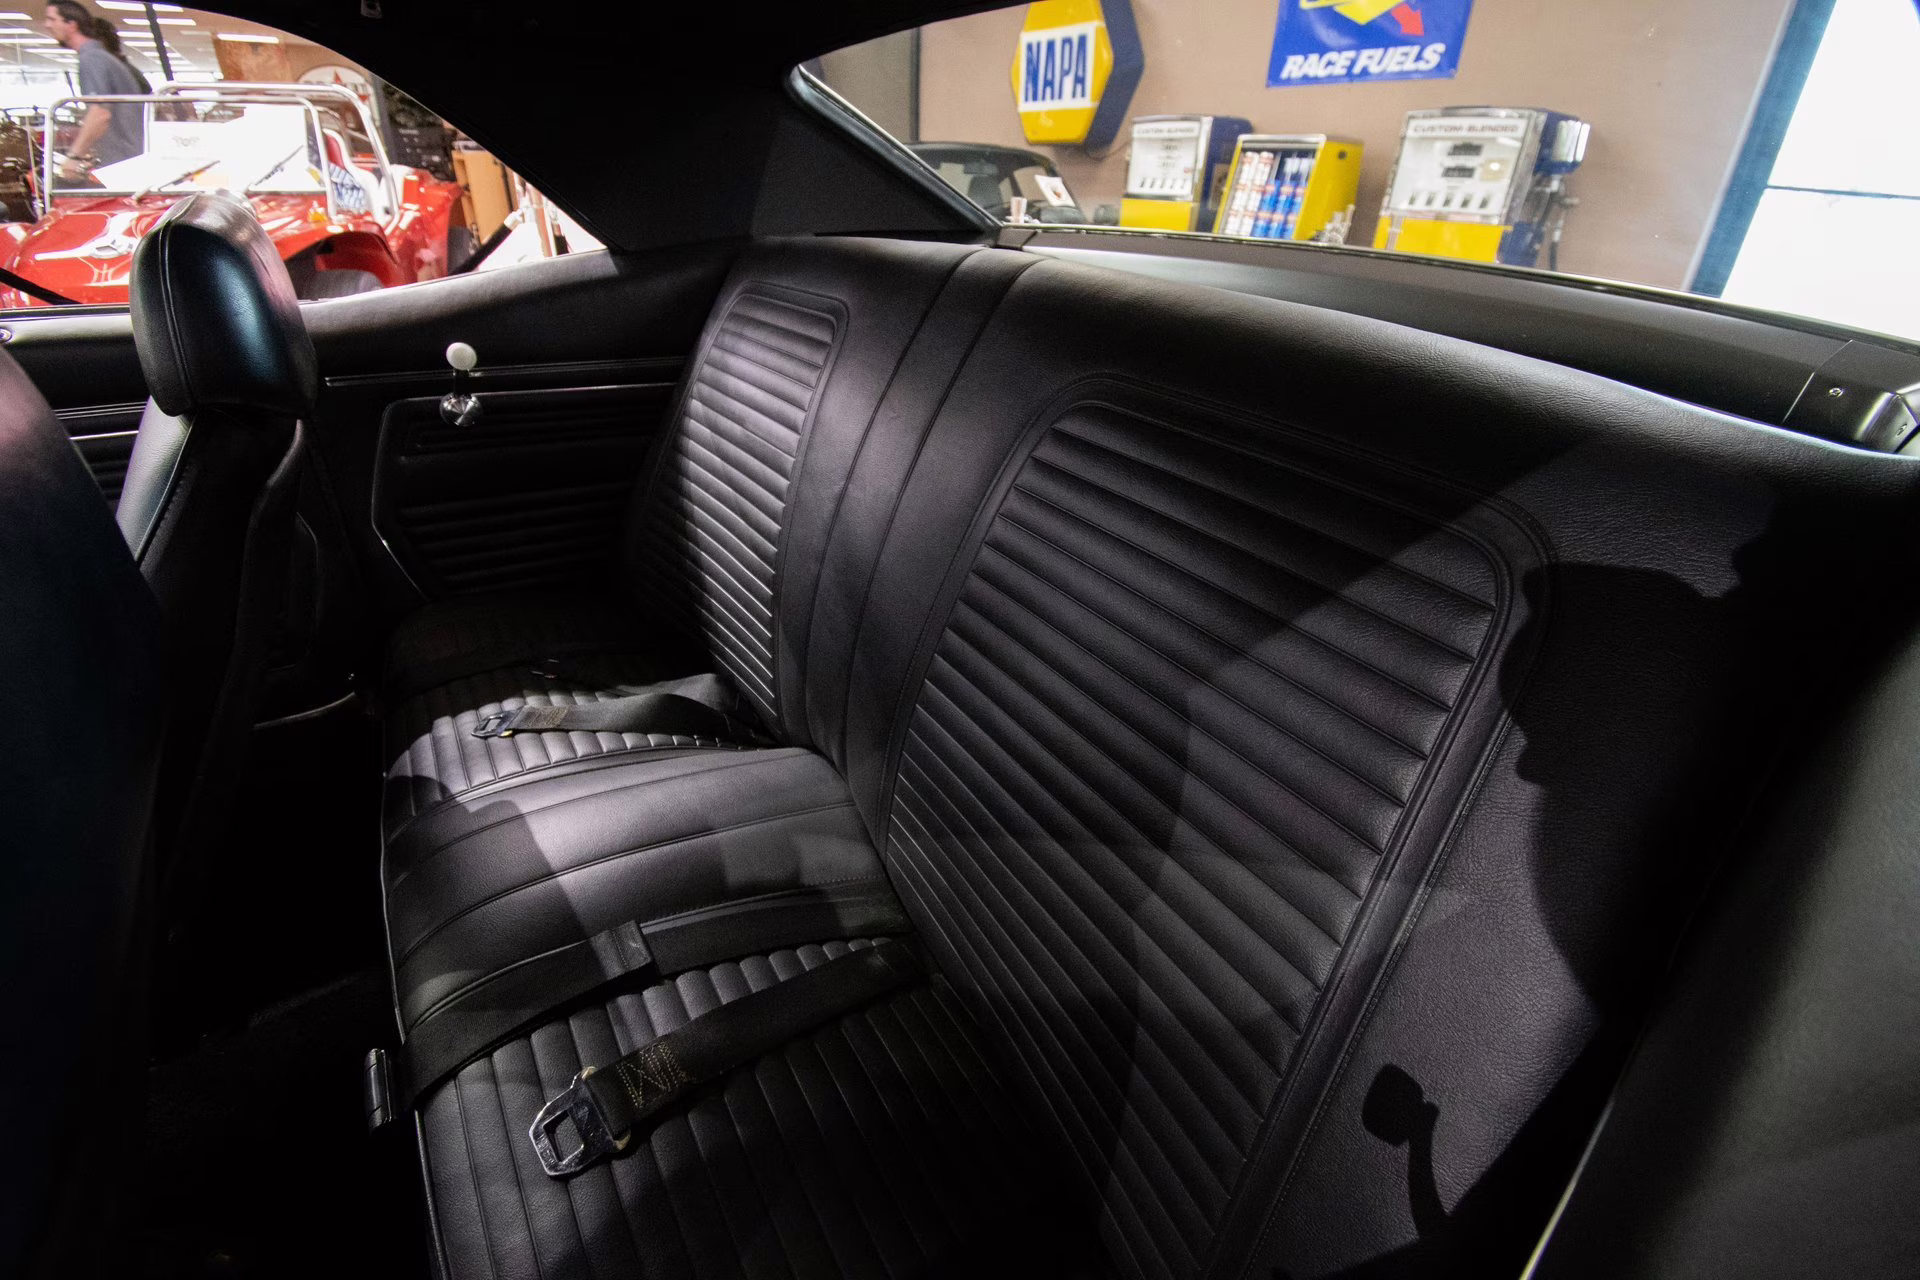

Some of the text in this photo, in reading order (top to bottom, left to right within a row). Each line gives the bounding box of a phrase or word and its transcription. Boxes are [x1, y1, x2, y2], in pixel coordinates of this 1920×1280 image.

[1024, 34, 1087, 102] NAPA
[1280, 43, 1446, 79] RACE FUELS
[1413, 124, 1464, 133] CUSTOM
